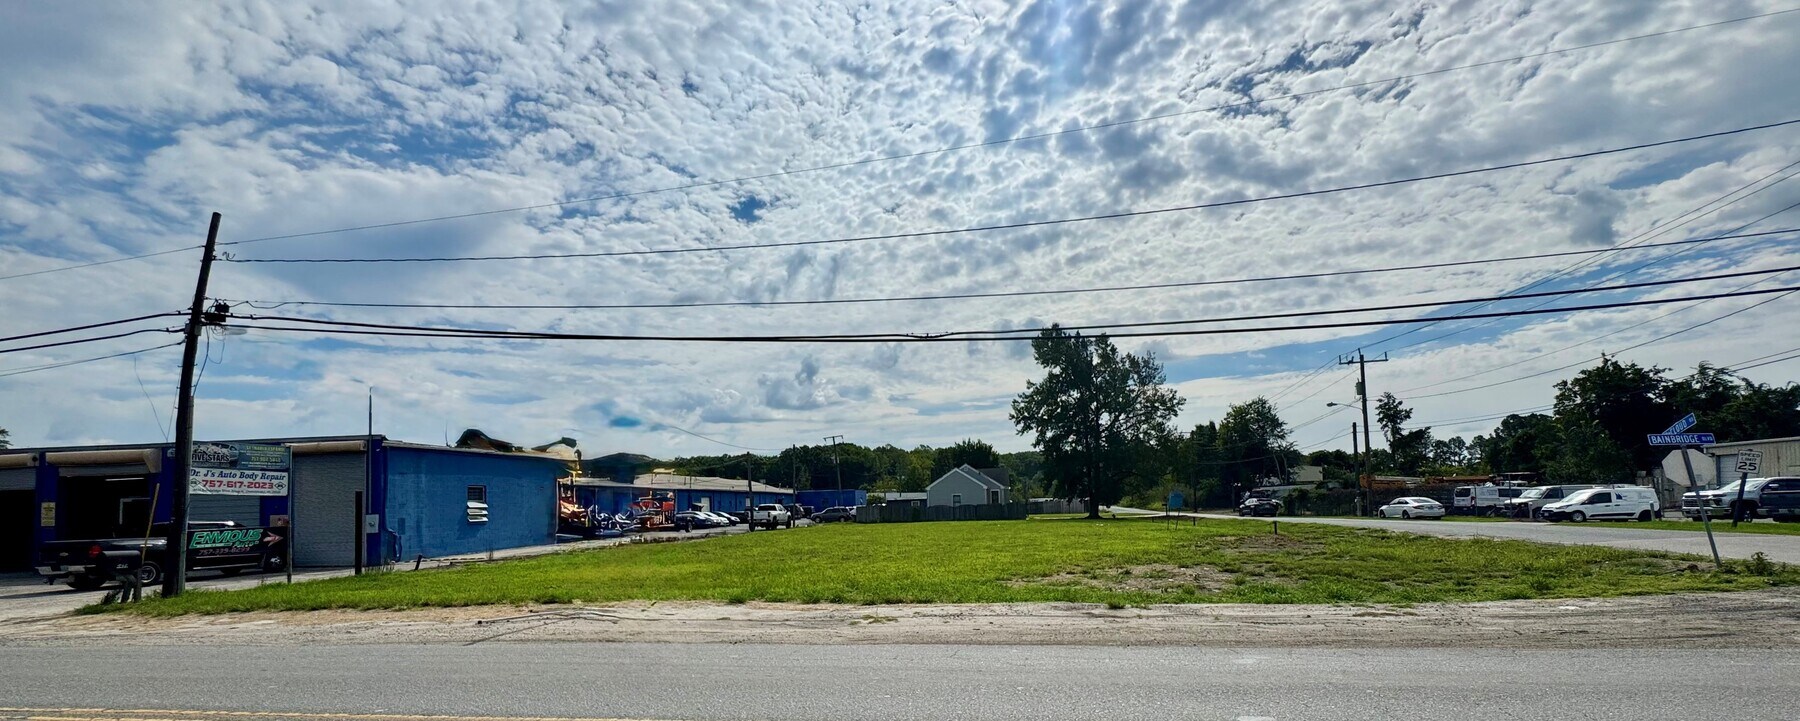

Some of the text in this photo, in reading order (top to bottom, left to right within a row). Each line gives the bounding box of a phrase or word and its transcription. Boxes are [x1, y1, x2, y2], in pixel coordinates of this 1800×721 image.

[1651, 435, 1700, 443] BAINBRIDGE
[207, 453, 230, 462] STARS
[1738, 461, 1757, 471] 25
[190, 469, 286, 482] Dr. J's Auto Body Repair
[202, 480, 274, 489] 757-617-2023
[189, 529, 264, 549] ENVIOUS
